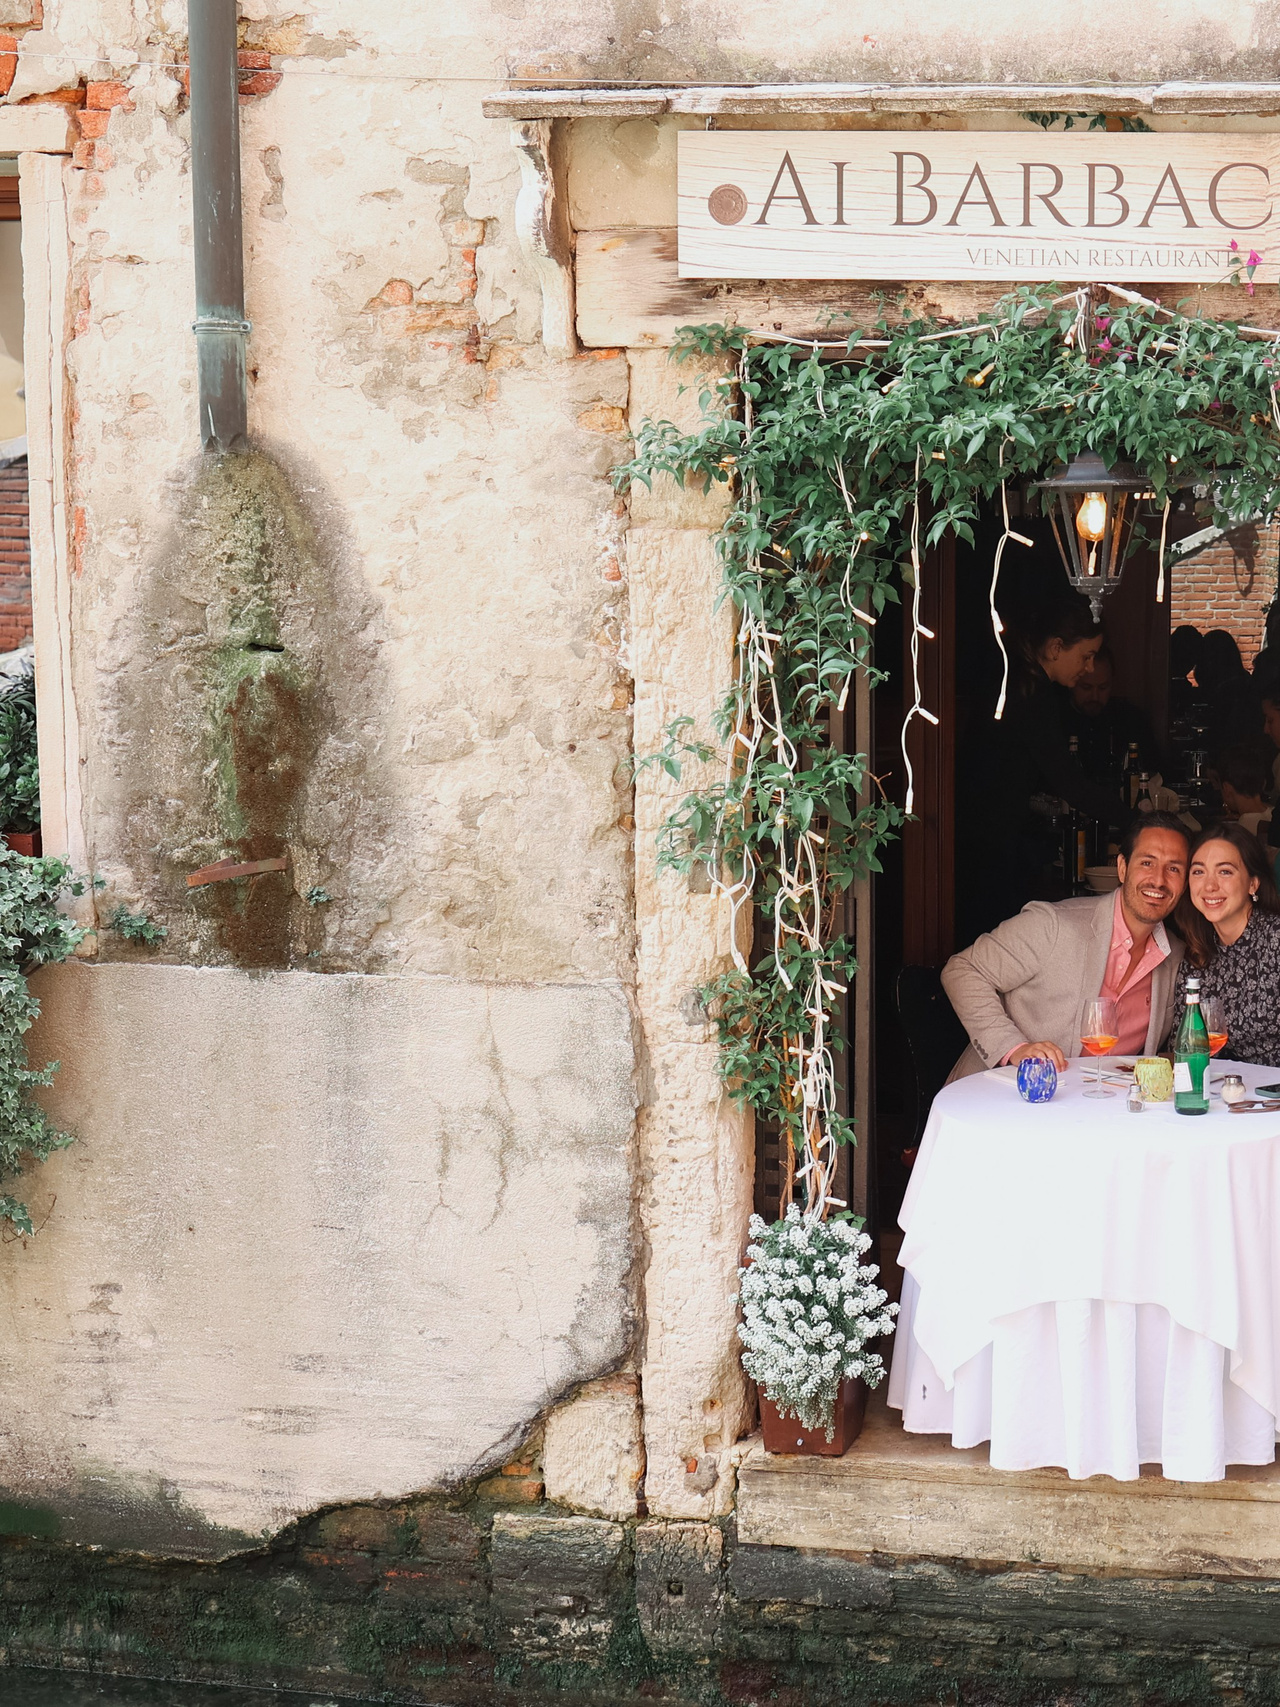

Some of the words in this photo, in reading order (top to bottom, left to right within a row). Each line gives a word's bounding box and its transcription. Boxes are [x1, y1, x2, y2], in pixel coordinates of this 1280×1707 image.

[750, 149, 851, 227] AI
[966, 248, 1081, 267] VENETIAN
[1088, 249, 1236, 268] RESTAURANT
